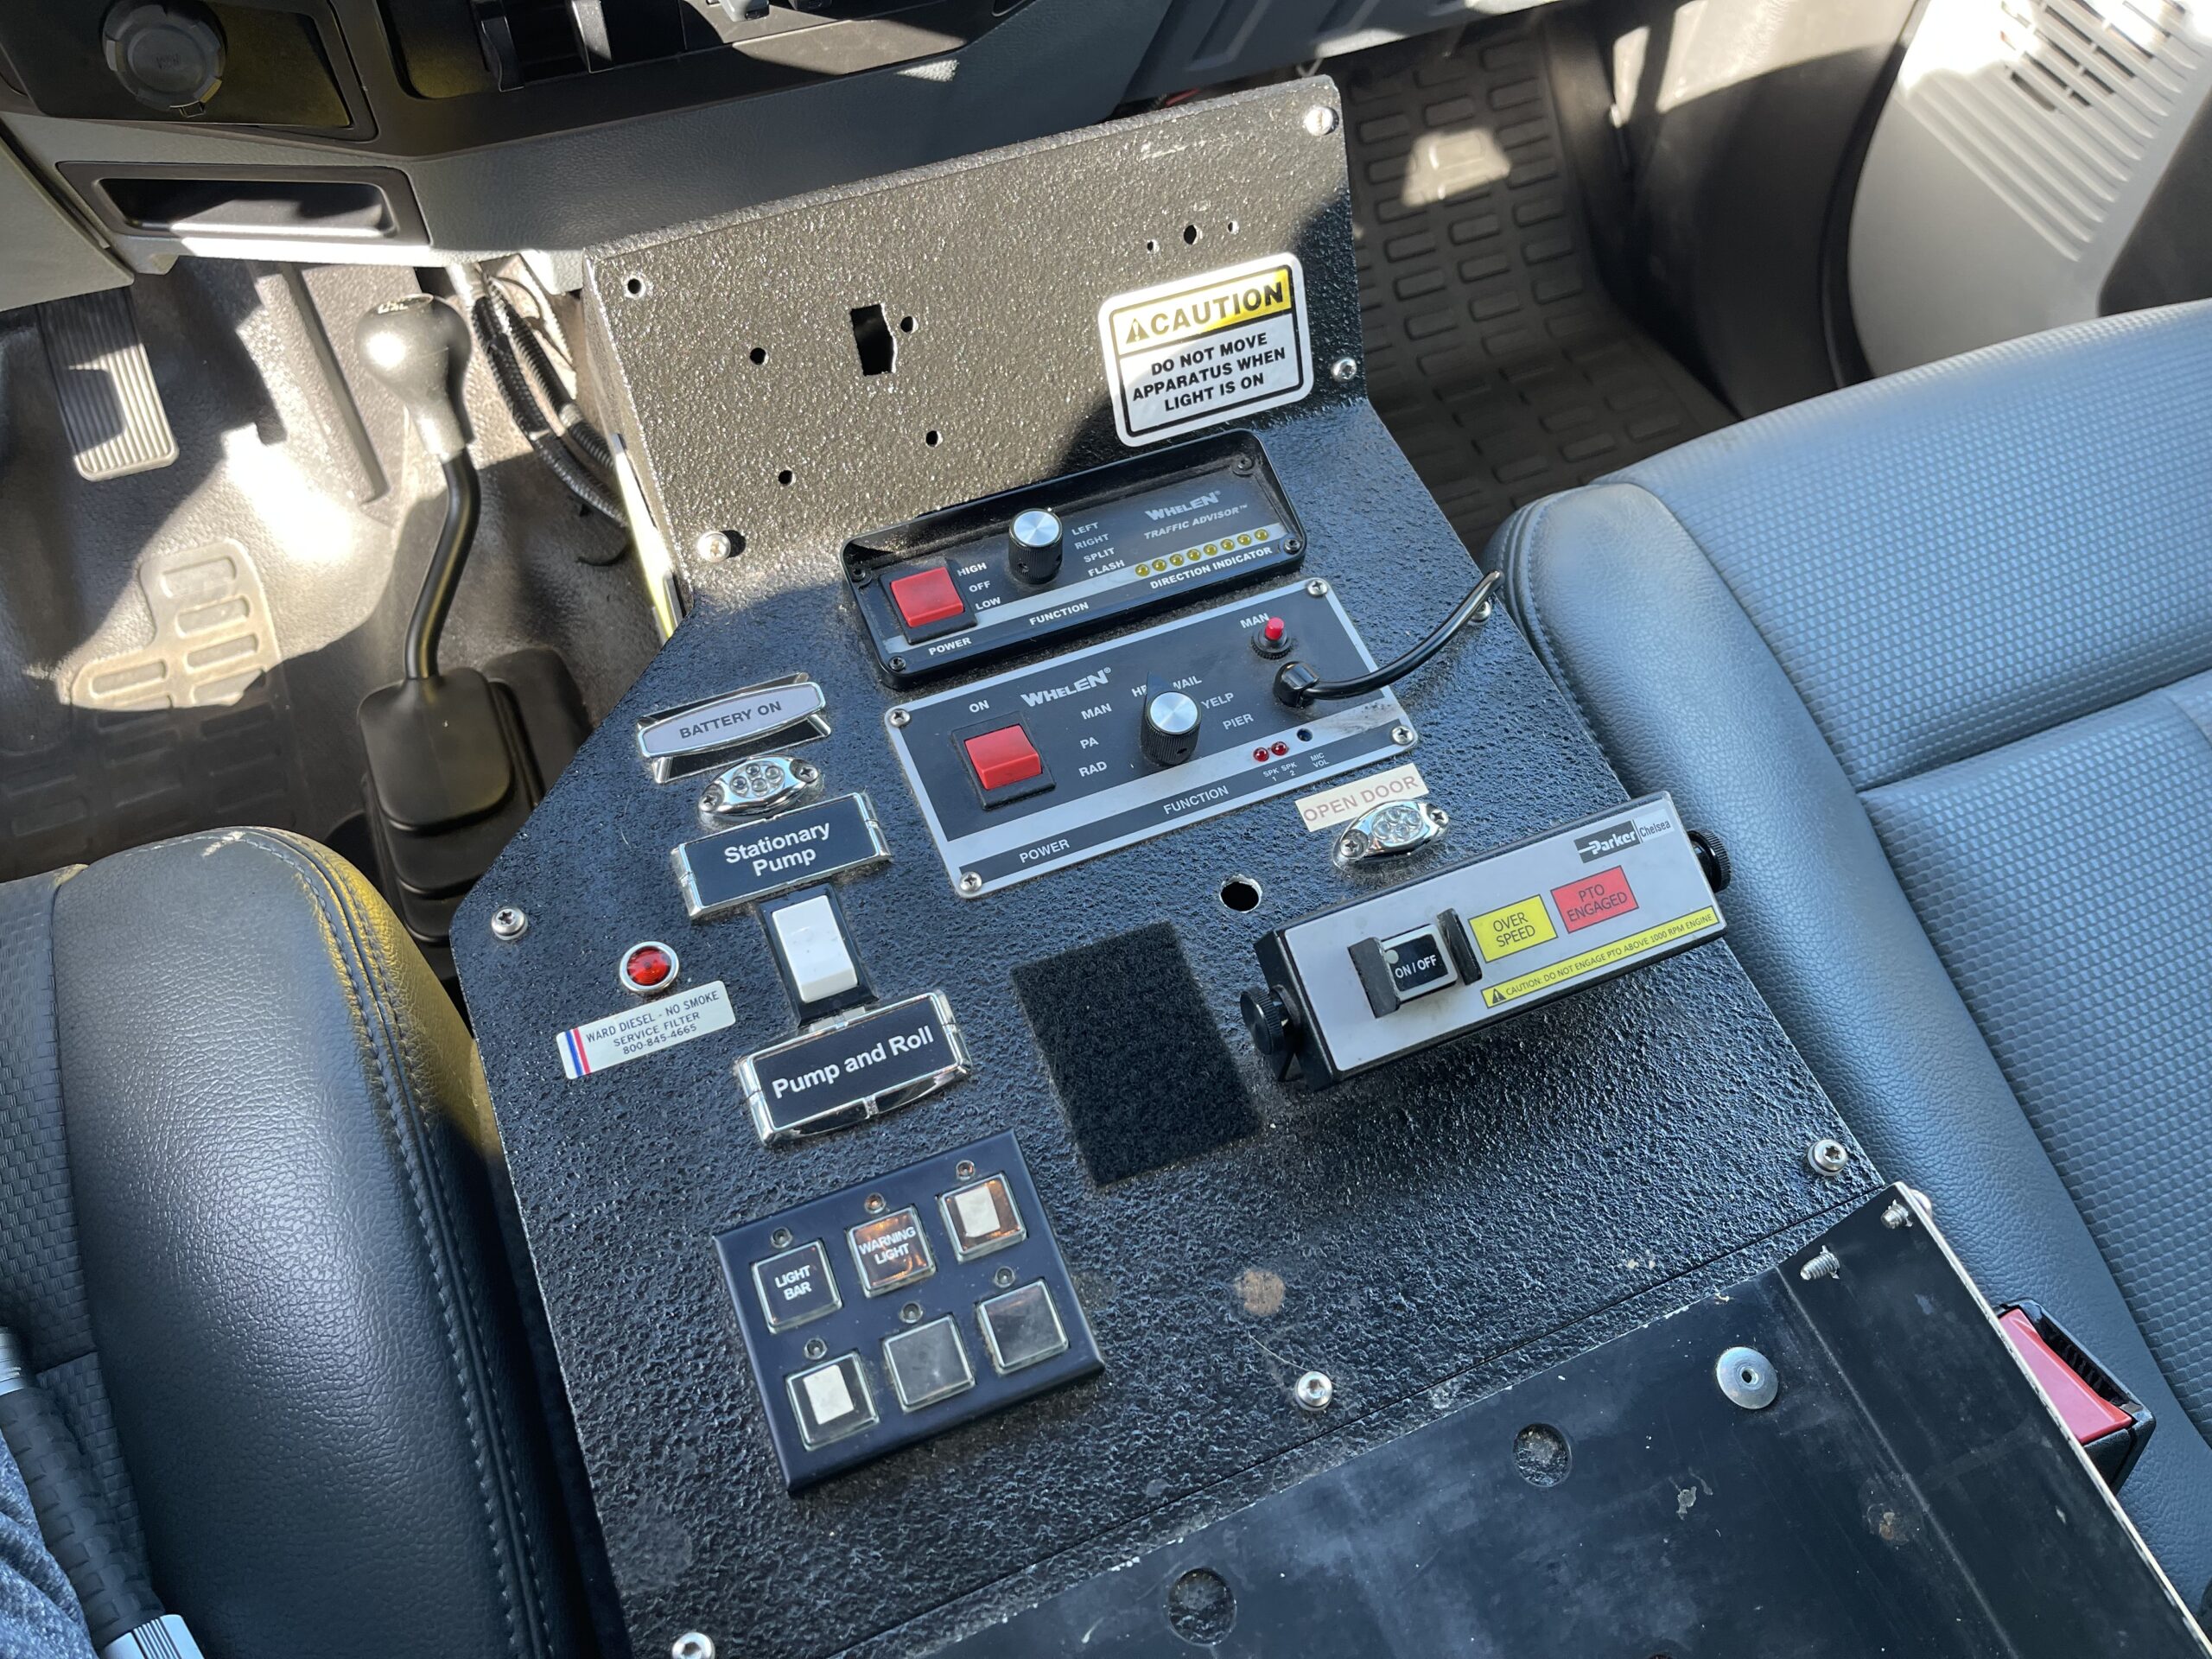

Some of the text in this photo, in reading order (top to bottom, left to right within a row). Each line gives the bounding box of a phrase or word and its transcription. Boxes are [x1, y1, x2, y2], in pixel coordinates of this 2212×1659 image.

[1150, 281, 1284, 336] CAUTION
[1152, 333, 1268, 376] DO NOT MOVE
[1133, 346, 1286, 401] APPARATUS WHEN
[1165, 372, 1264, 412] LIGHT IS ON
[1071, 521, 1100, 536] LEFT
[1143, 520, 1190, 540] TRAFFIC
[1074, 532, 1109, 550] RIGHT
[1084, 547, 1116, 563] SPLIT
[957, 562, 988, 577] HIGH
[1088, 559, 1125, 577] FLASH
[1149, 546, 1273, 590] DIRECTION INDICATOR
[969, 580, 991, 593] OFF
[975, 596, 1001, 611] LOW
[1029, 601, 1090, 626] FUNCTION
[1239, 613, 1269, 629] MAN
[928, 636, 972, 657] POWER
[968, 698, 991, 714] ON
[1080, 702, 1113, 720] MAN
[1201, 692, 1235, 709] YELP
[678, 700, 783, 741] BATTERY ON
[1222, 713, 1255, 730] PIER
[1079, 736, 1100, 750] PA
[1310, 752, 1325, 762] MIC
[1312, 759, 1330, 769] VOL
[1078, 760, 1108, 778] RAD
[1262, 761, 1298, 779] SPK SPK
[1162, 785, 1230, 817] FUNCTION
[1303, 775, 1419, 823] OPEN DOOR
[723, 821, 830, 865] Stationary
[1586, 820, 1671, 855] Parker Chelsea
[752, 847, 817, 877] Pump
[1019, 838, 1071, 864] POWER
[1578, 883, 1605, 902] PTO
[1567, 891, 1628, 922] ENGAGED
[1492, 912, 1529, 932] OVER
[1496, 925, 1535, 948] SPEED
[1505, 913, 1713, 995] CAUTION: DO NOT ENGAGE PTO ABOVE 1000 RPM ENGINE
[586, 1026, 616, 1044] WARD
[619, 1013, 655, 1033] DIESEL
[665, 1003, 681, 1016] NO
[683, 990, 720, 1010] SMOKE
[613, 1012, 701, 1047] SERVICE FILTER
[622, 1023, 697, 1055] 800-845-4665
[772, 1027, 935, 1099] Pump and Roll
[859, 1225, 917, 1255] WARNING
[874, 1242, 911, 1266] LIGHT
[774, 1265, 811, 1289] LIGHT
[783, 1281, 812, 1300] BAR
